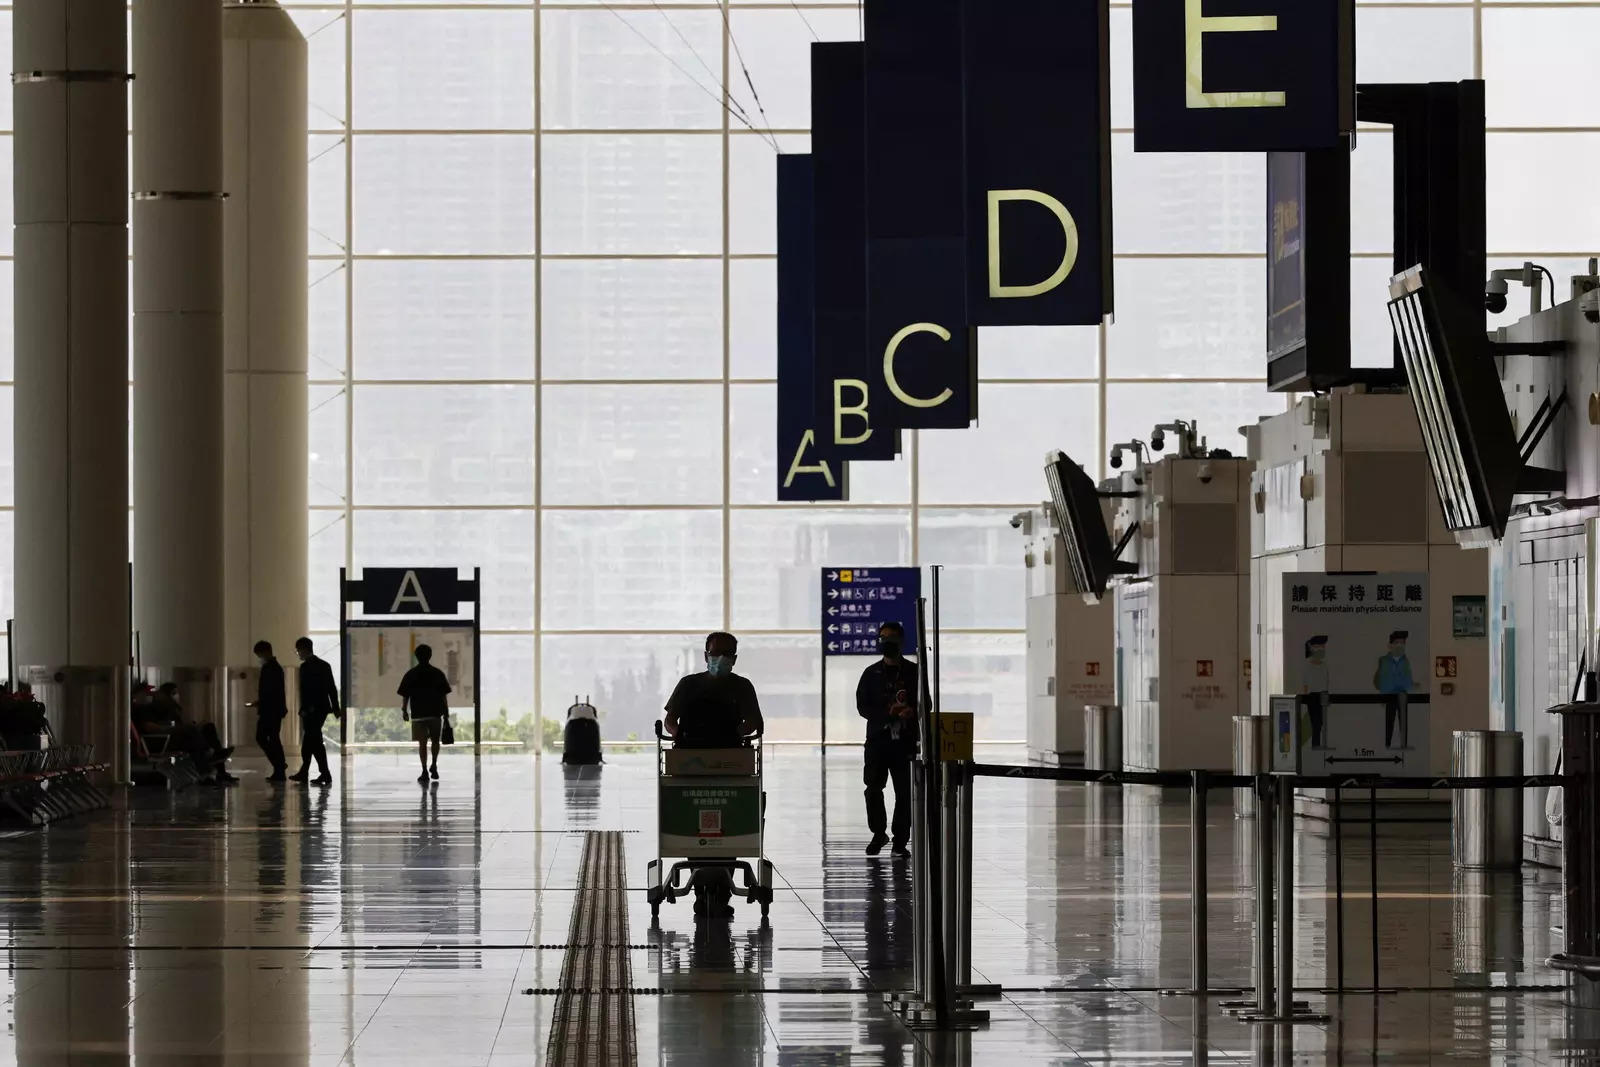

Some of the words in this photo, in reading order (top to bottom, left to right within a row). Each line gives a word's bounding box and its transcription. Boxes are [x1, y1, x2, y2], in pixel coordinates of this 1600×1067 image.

[1185, 0, 1286, 108] E
[987, 189, 1078, 298] D
[883, 322, 953, 408] C
[833, 379, 873, 445] B
[784, 429, 836, 487] A
[390, 570, 431, 612] A
[1291, 605, 1317, 614] Please
[1319, 605, 1354, 614] maintain
[1356, 605, 1388, 615] physical
[1389, 605, 1423, 614] distance
[1292, 584, 1423, 602] 請保持距離
[943, 739, 956, 752] In
[1354, 748, 1375, 757] 1.5m
